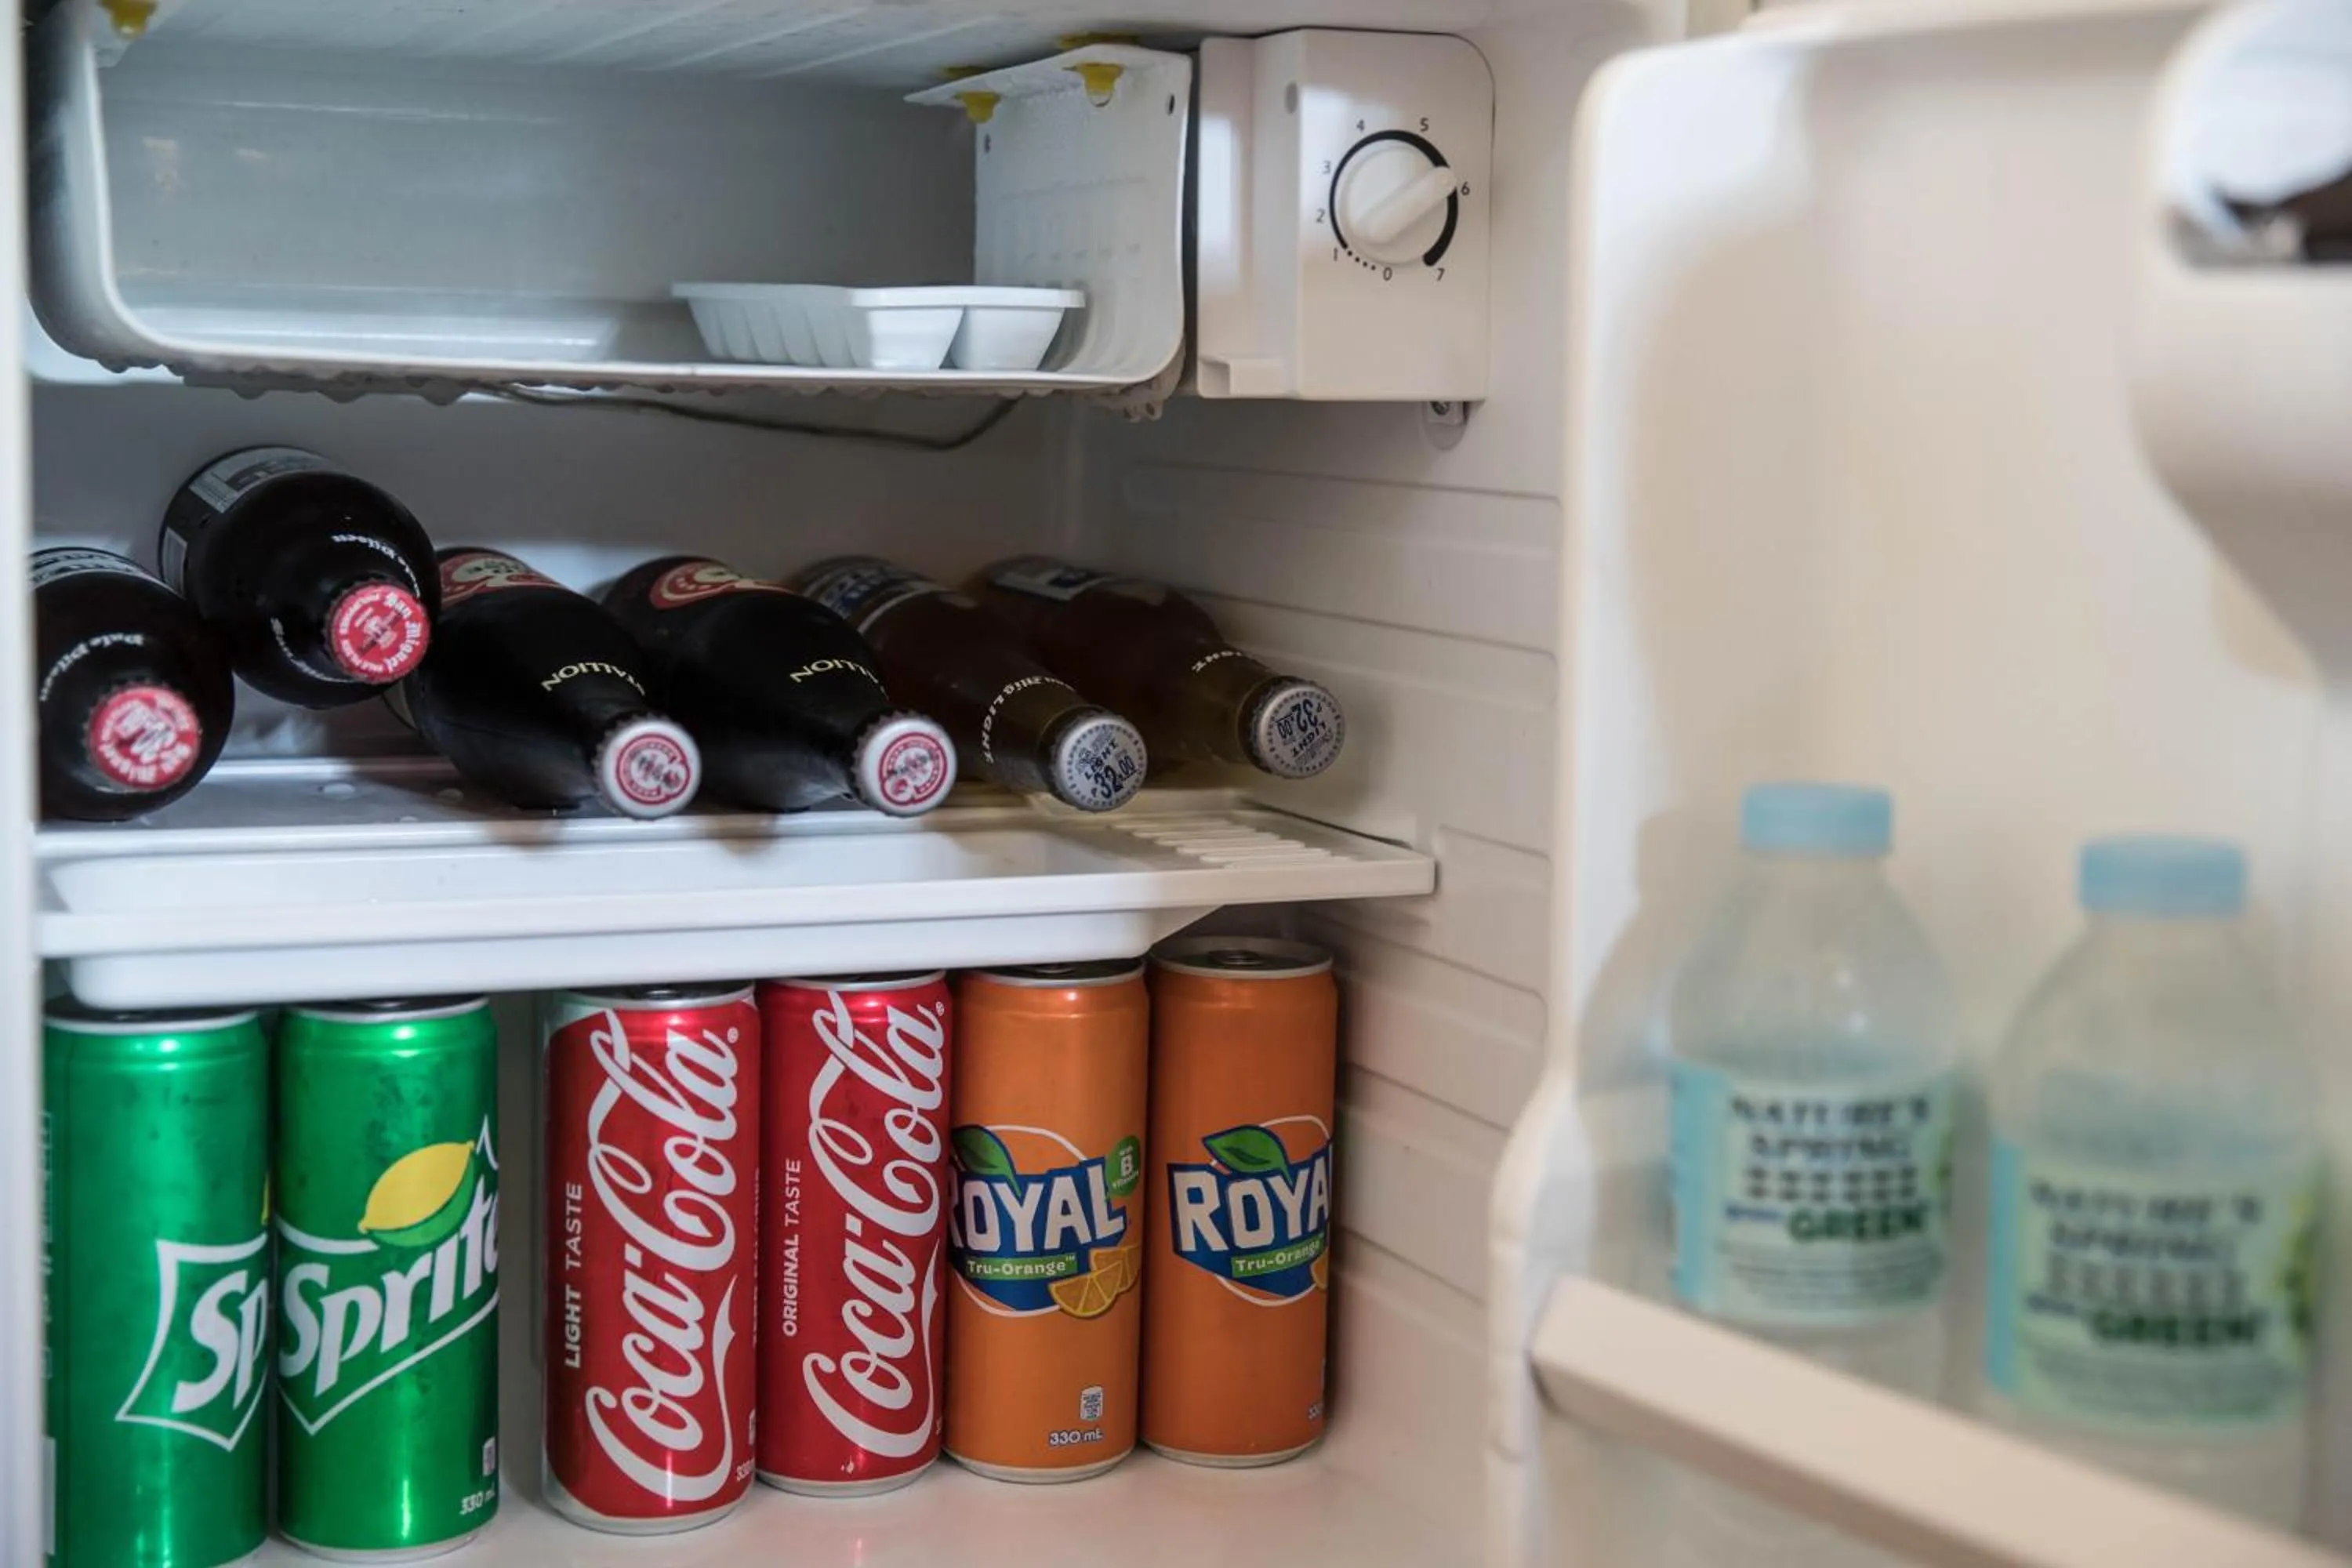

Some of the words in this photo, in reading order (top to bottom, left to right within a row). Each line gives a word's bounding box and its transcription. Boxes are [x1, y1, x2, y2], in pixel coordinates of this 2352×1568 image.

[1356, 119, 1365, 131] 4
[1420, 118, 1428, 131] 5
[1322, 160, 1331, 174] 3
[1461, 181, 1470, 195] 6
[1316, 208, 1325, 223] 2
[1382, 267, 1392, 281] 0
[1436, 268, 1445, 281] 7
[1292, 720, 1327, 757] LIGHT
[785, 1158, 801, 1227] TASTE
[1174, 1145, 1332, 1252] ROYA
[566, 1182, 583, 1270] TASTE
[782, 1234, 799, 1337] ORIGINAL
[565, 1283, 582, 1368] LIGHT
[1050, 1431, 1081, 1445] 330
